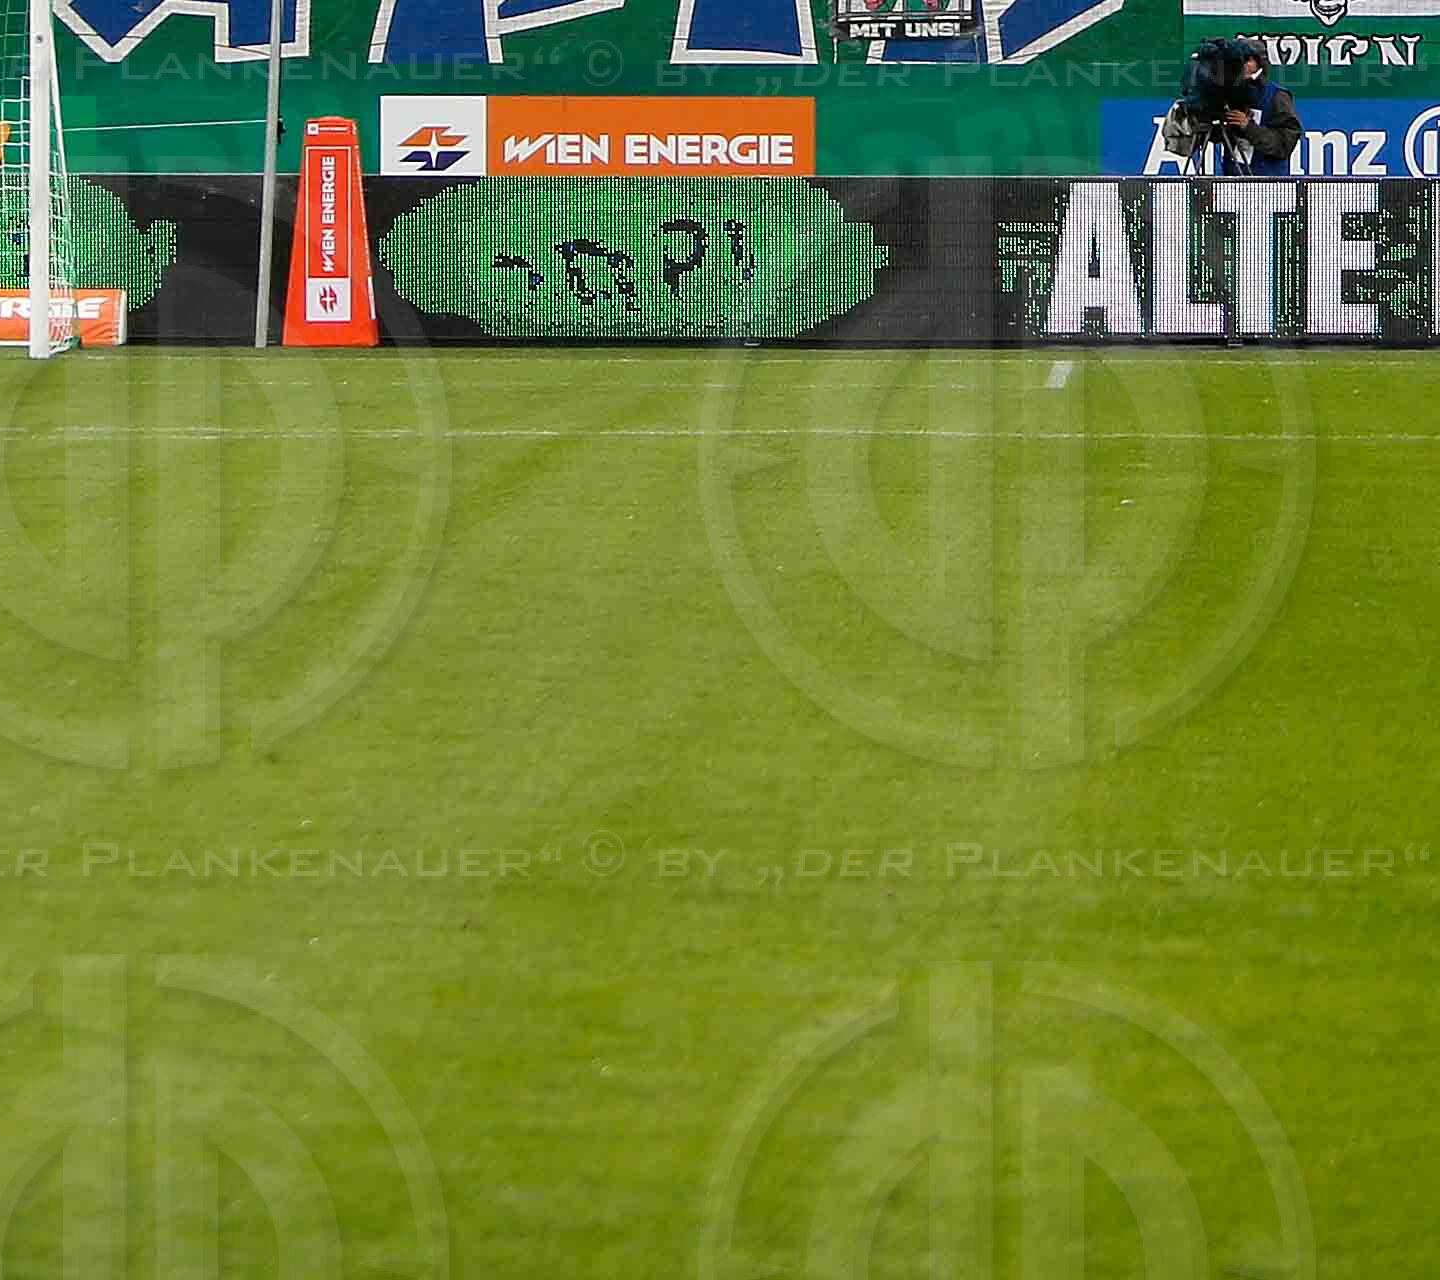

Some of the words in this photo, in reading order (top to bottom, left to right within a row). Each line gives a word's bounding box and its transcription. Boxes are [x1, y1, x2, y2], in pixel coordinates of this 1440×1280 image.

[850, 22, 896, 38] MIT
[905, 22, 960, 38] UNS!
[503, 133, 610, 167] WIEN
[625, 133, 796, 167] ENERGIE
[321, 155, 336, 225] ENERGIE
[322, 228, 336, 273] WIEN
[1046, 181, 1378, 336] ALTE
